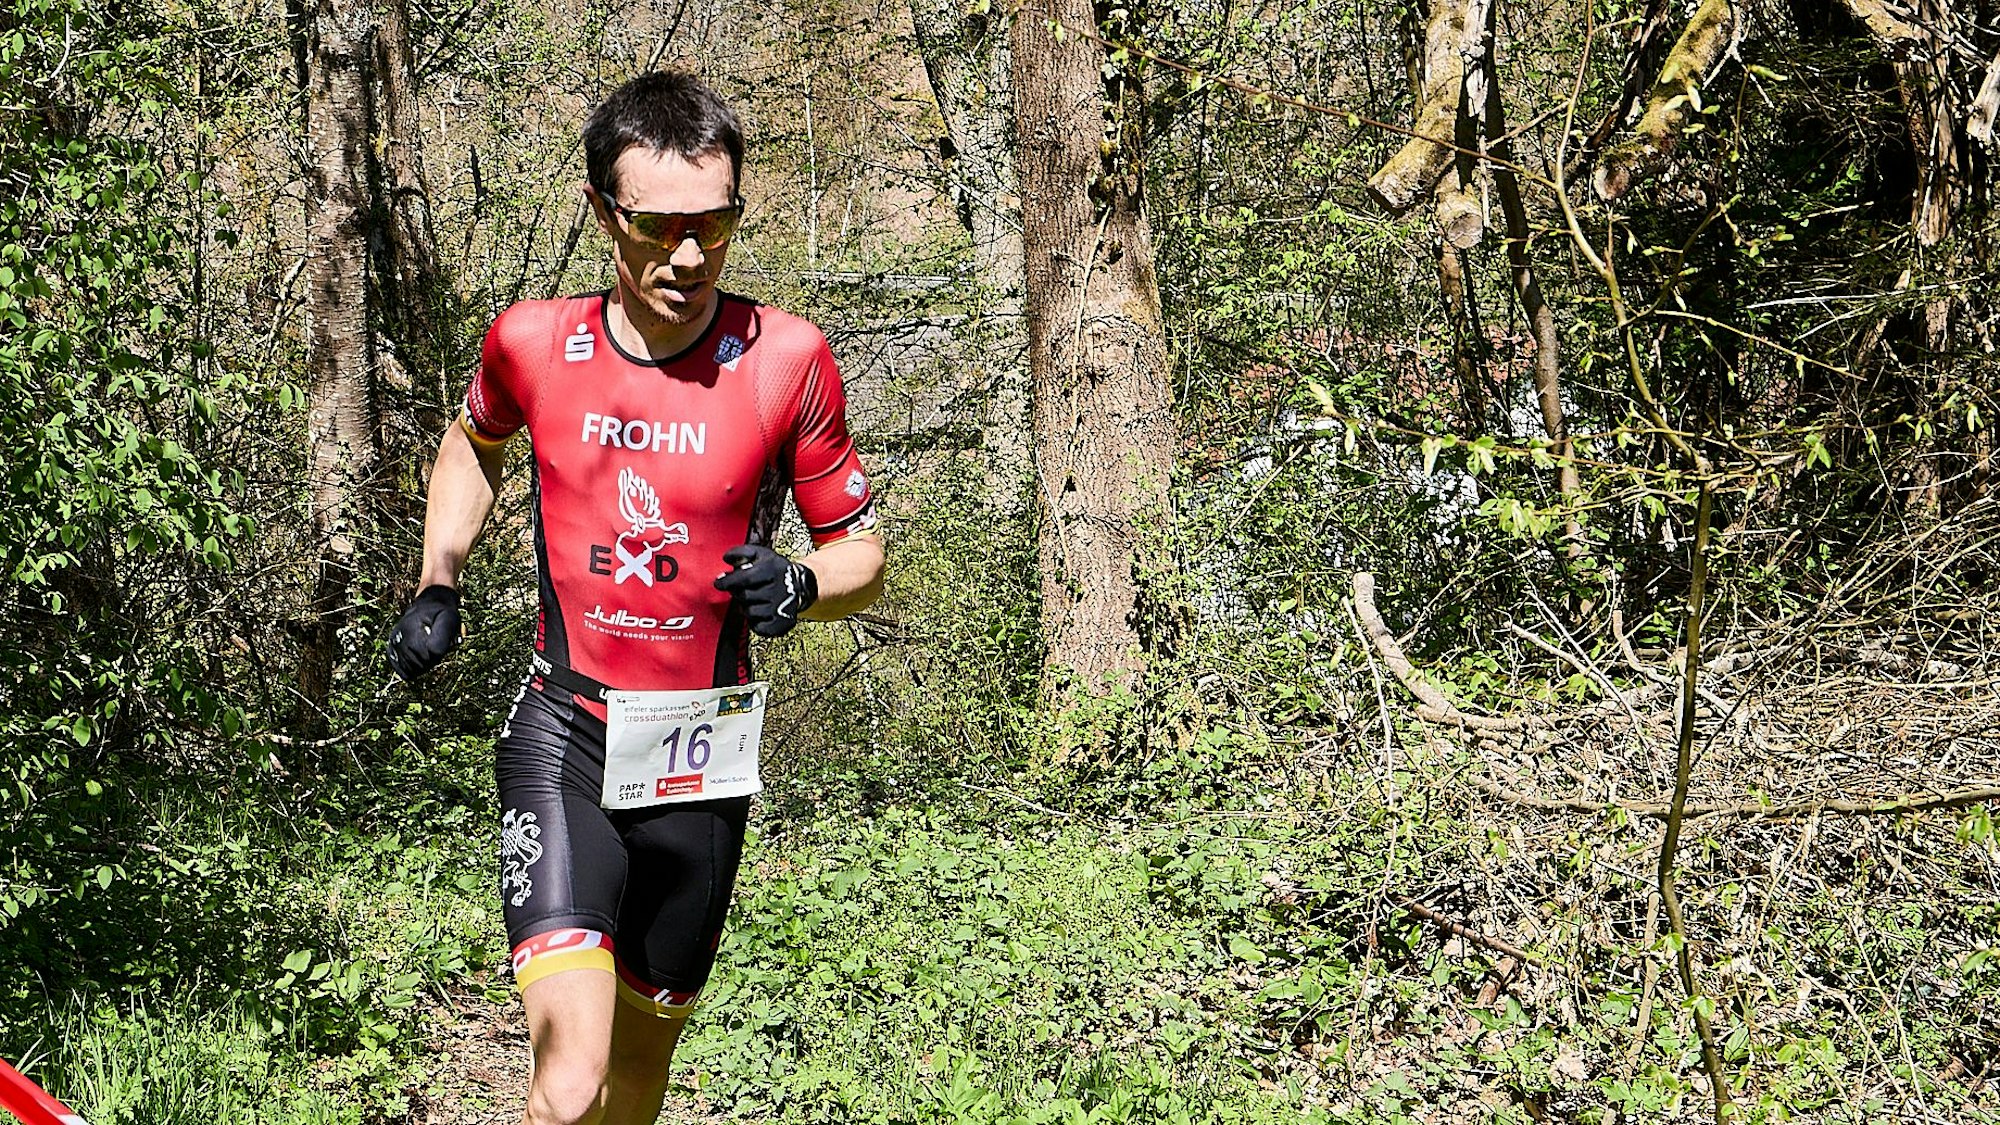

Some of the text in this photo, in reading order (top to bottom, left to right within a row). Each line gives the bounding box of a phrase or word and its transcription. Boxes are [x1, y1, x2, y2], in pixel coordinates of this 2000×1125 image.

[581, 412, 706, 454] FROHN
[589, 541, 679, 587] EXD
[583, 605, 657, 629] Julbo
[584, 620, 598, 630] The
[599, 627, 621, 637] world
[623, 632, 648, 640] needs
[624, 712, 689, 723] crossduathlon
[649, 705, 690, 713] sparkassen
[662, 723, 713, 774] 16
[618, 791, 643, 801] STAR
